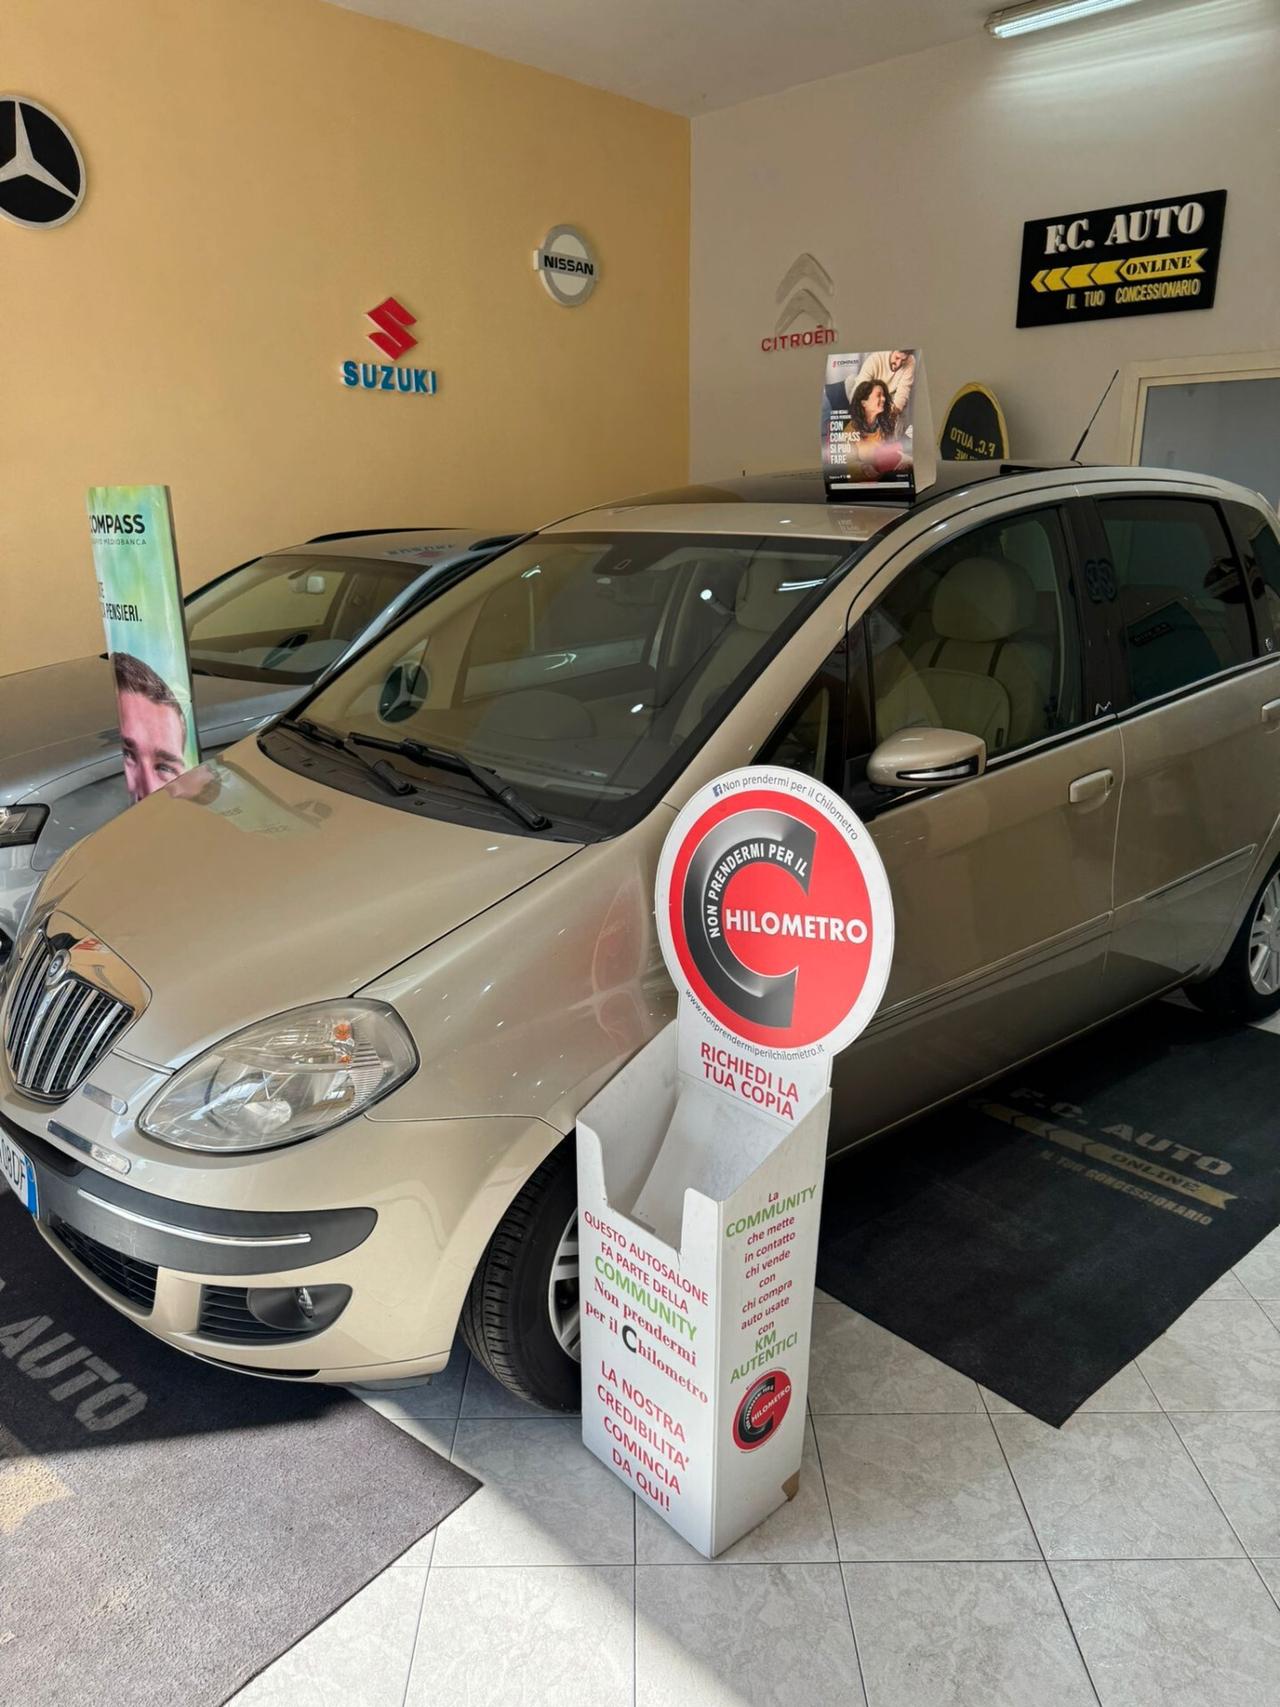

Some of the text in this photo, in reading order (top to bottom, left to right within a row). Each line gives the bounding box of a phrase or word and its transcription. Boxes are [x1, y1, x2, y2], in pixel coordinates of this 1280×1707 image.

[1044, 202, 1205, 254] F.C. AUTO
[543, 254, 594, 276] NISSAN
[1126, 255, 1192, 276] ONLINE
[1066, 279, 1201, 310] IL TUO CONCESSIONARIO
[341, 361, 438, 395] SUZUKI
[829, 420, 844, 432] CON
[829, 431, 861, 443] COMPASS
[830, 454, 848, 465] FARE
[722, 774, 858, 841] Non prendermi per il Chilometro
[707, 843, 808, 939] NON PRENDERMI PER IL
[685, 989, 825, 1061] www.nonprendermiperilchilometro.it
[700, 1041, 799, 1103] RICHIEDI LA
[703, 1061, 794, 1120] TUA COPIA
[1101, 1123, 1235, 1176] AUTO
[1111, 1153, 1202, 1193] ONLINE
[725, 1184, 817, 1238] COMMUNITY
[768, 1191, 779, 1203] La
[1085, 1168, 1214, 1226] CONCESSIONARIO
[744, 1231, 796, 1264] in contatto
[746, 1216, 795, 1246] che mette
[584, 1211, 709, 1306] QUESTO AUTOSALONE
[601, 1241, 688, 1314] FA PARTE DELLA
[745, 1249, 791, 1279] chi vende
[759, 1273, 776, 1288] con
[594, 1277, 697, 1366] Non prendermi
[595, 1256, 697, 1341] COMMUNITY
[741, 1296, 790, 1330] auto usate
[742, 1279, 793, 1314] chi compra
[585, 1300, 709, 1404] per il Chilometro
[755, 1329, 777, 1354] KM
[758, 1320, 775, 1336] con
[0, 1315, 148, 1432] AUTO
[730, 1331, 798, 1384] AUTENTICI
[597, 1384, 690, 1471] CREDIBILITA'
[601, 1360, 686, 1443] LA NOSTRA
[604, 1416, 681, 1495] COMINCIA
[612, 1448, 670, 1512] DA QUI!
